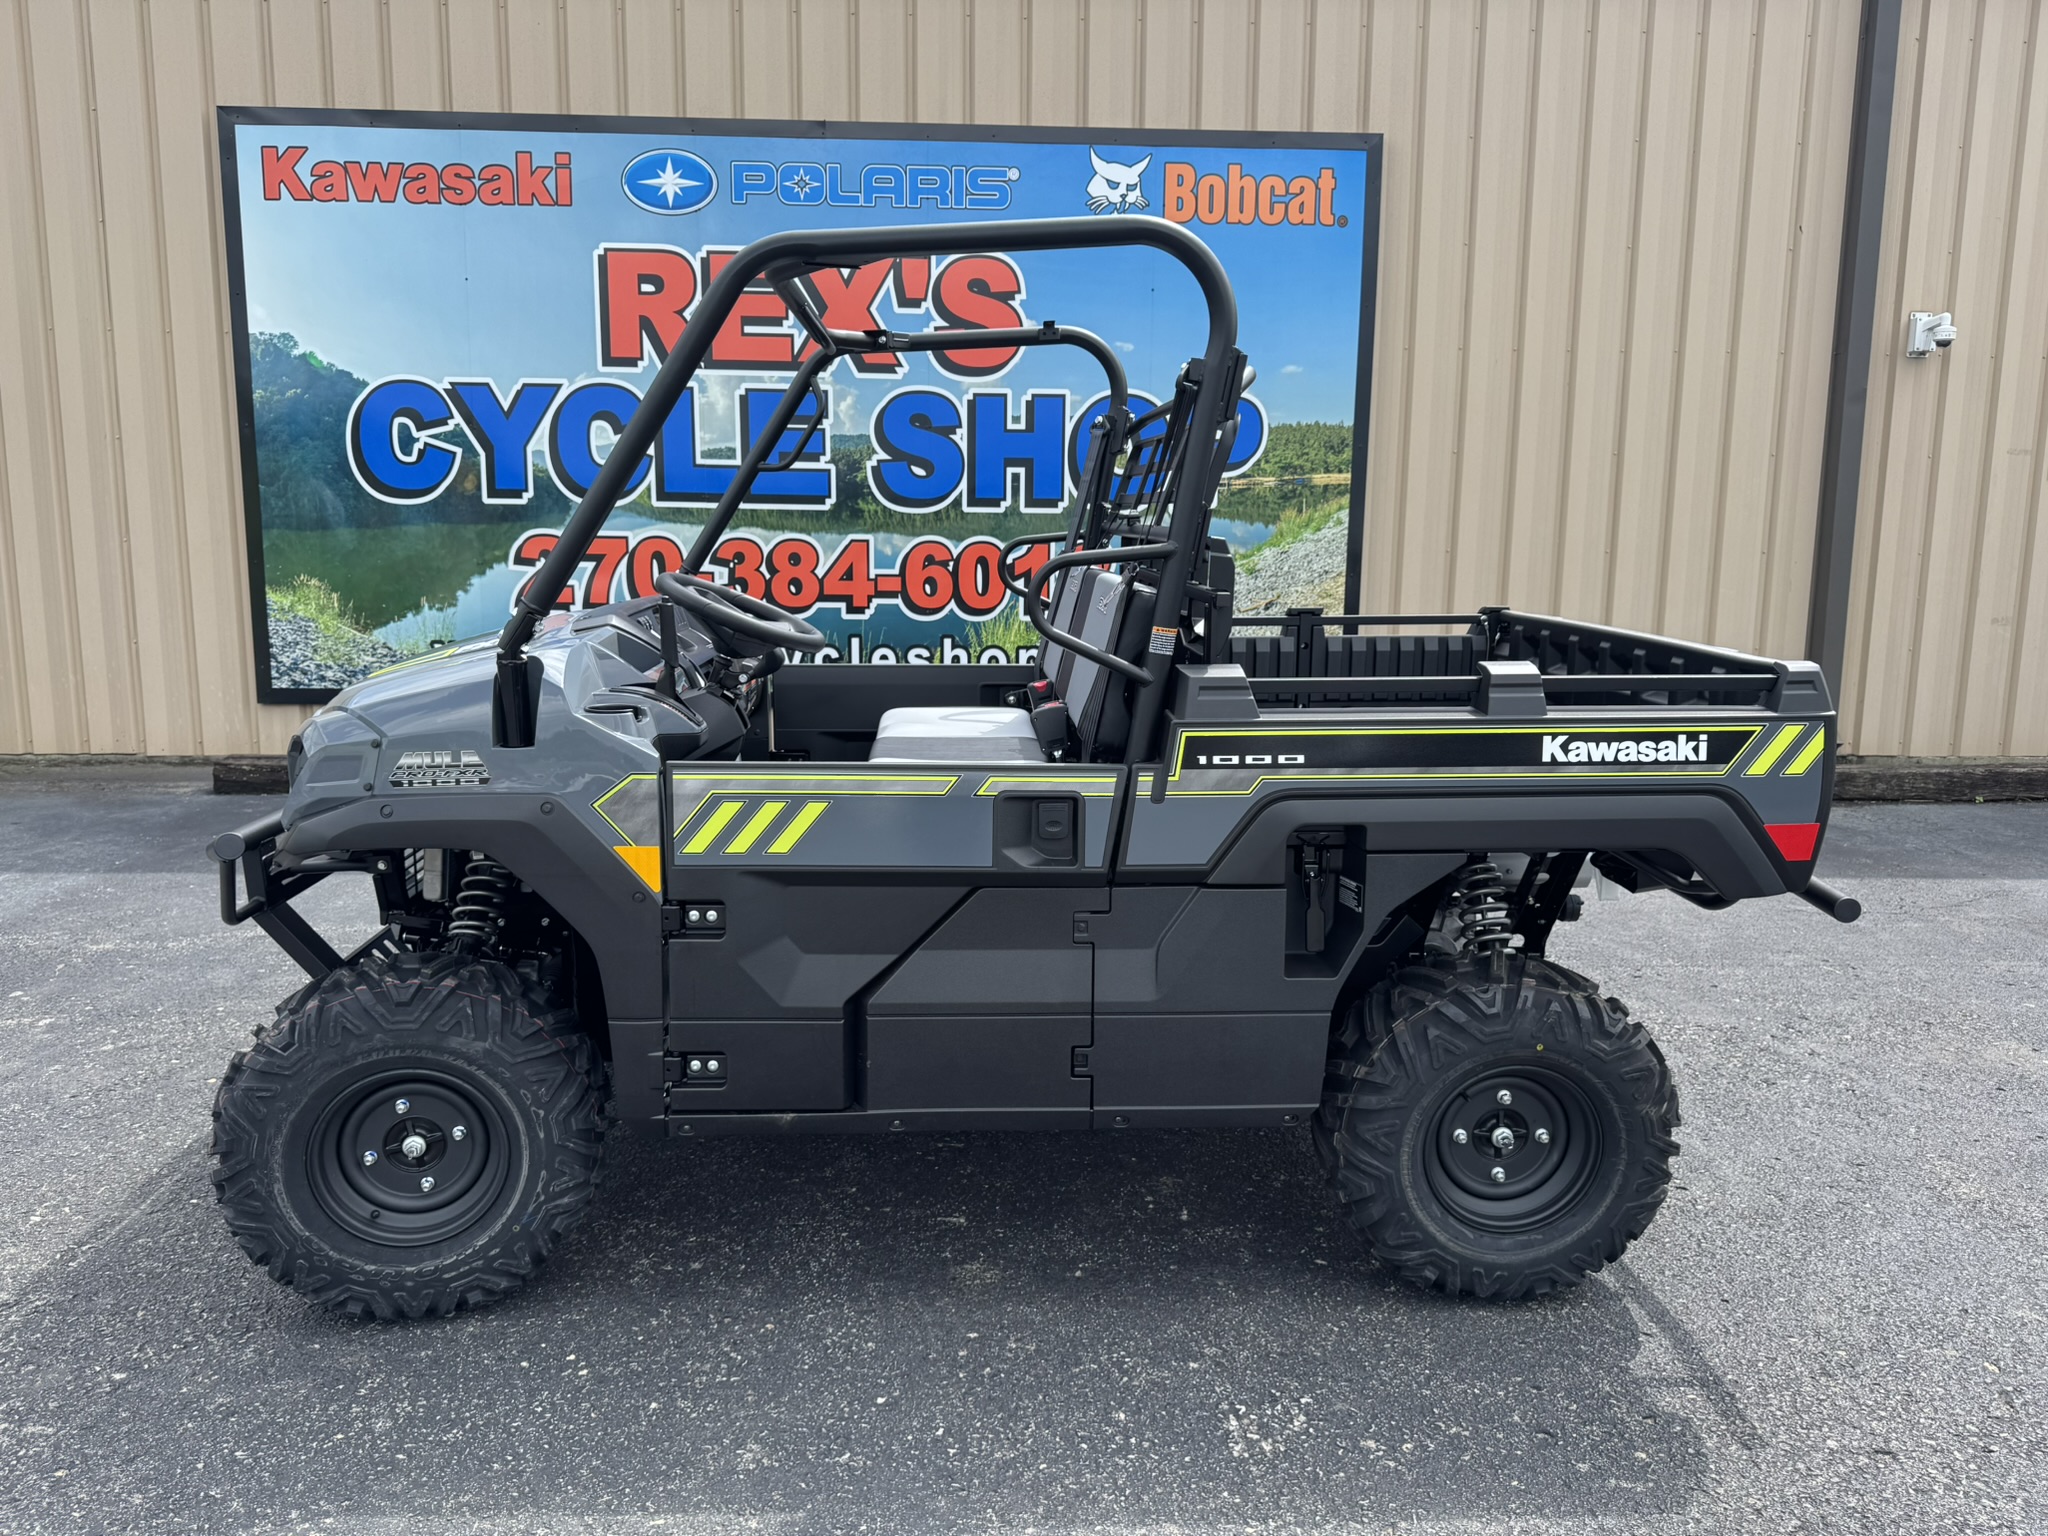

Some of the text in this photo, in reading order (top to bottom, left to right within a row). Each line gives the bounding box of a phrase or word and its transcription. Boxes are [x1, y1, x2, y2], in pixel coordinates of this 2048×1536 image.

[260, 145, 573, 207] Kawasaki
[730, 161, 1012, 209] POLARIS
[1163, 162, 1337, 227] Bobcat
[594, 242, 1027, 382] REX'S
[346, 374, 1269, 514] CYCLE SHOP
[509, 528, 1121, 620] 270-384-601
[393, 750, 487, 770] MULE
[1196, 754, 1305, 765] 1000
[1541, 734, 1709, 764] Kawasaki
[400, 778, 480, 787] 1000
